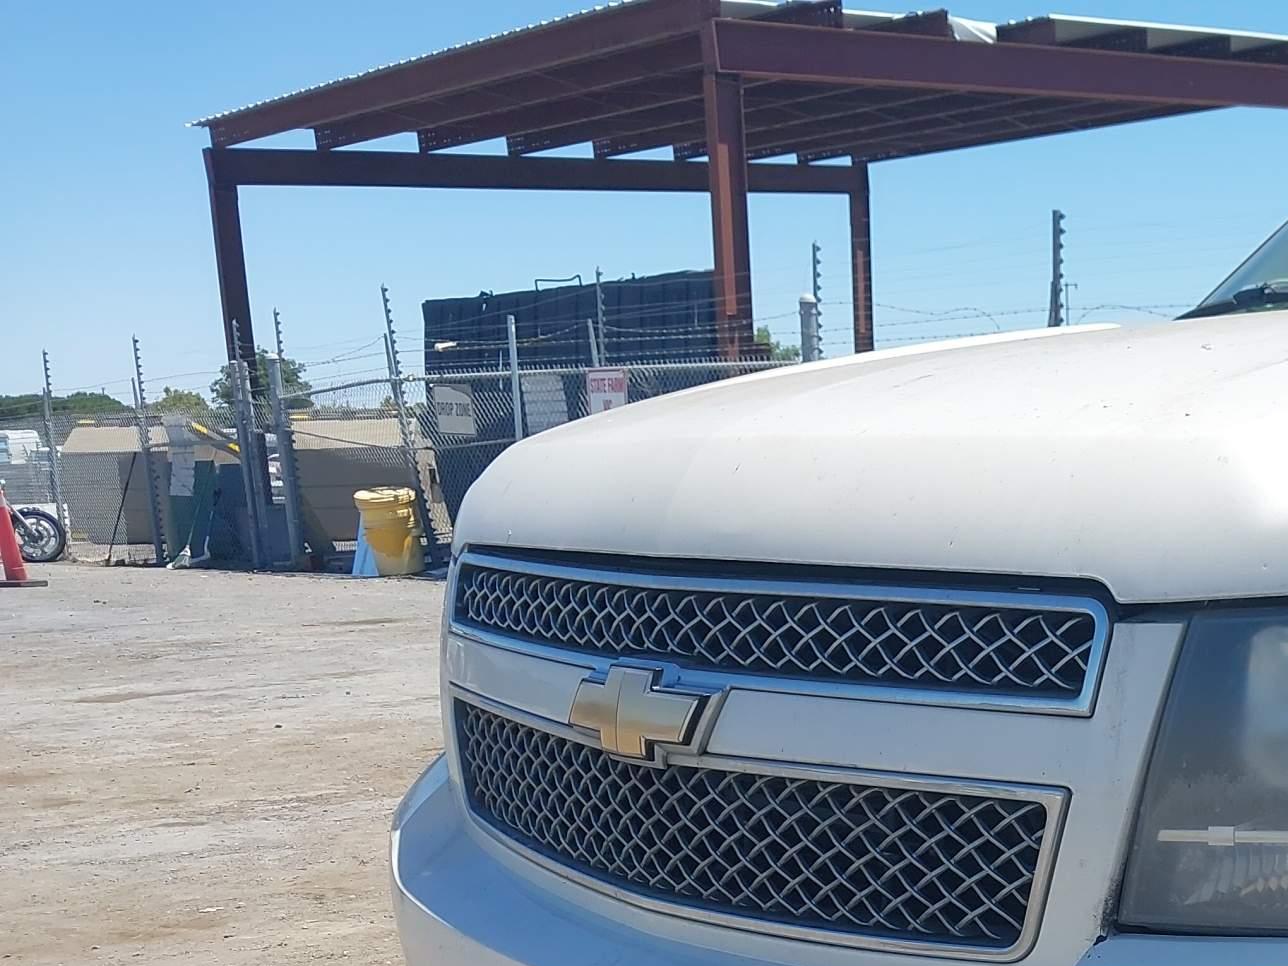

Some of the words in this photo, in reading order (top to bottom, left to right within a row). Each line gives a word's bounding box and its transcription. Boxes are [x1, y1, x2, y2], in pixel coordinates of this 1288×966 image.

[591, 378, 607, 393] STATE
[608, 377, 625, 393] FARM
[436, 401, 453, 416] DROP
[455, 402, 472, 417] ZONE
